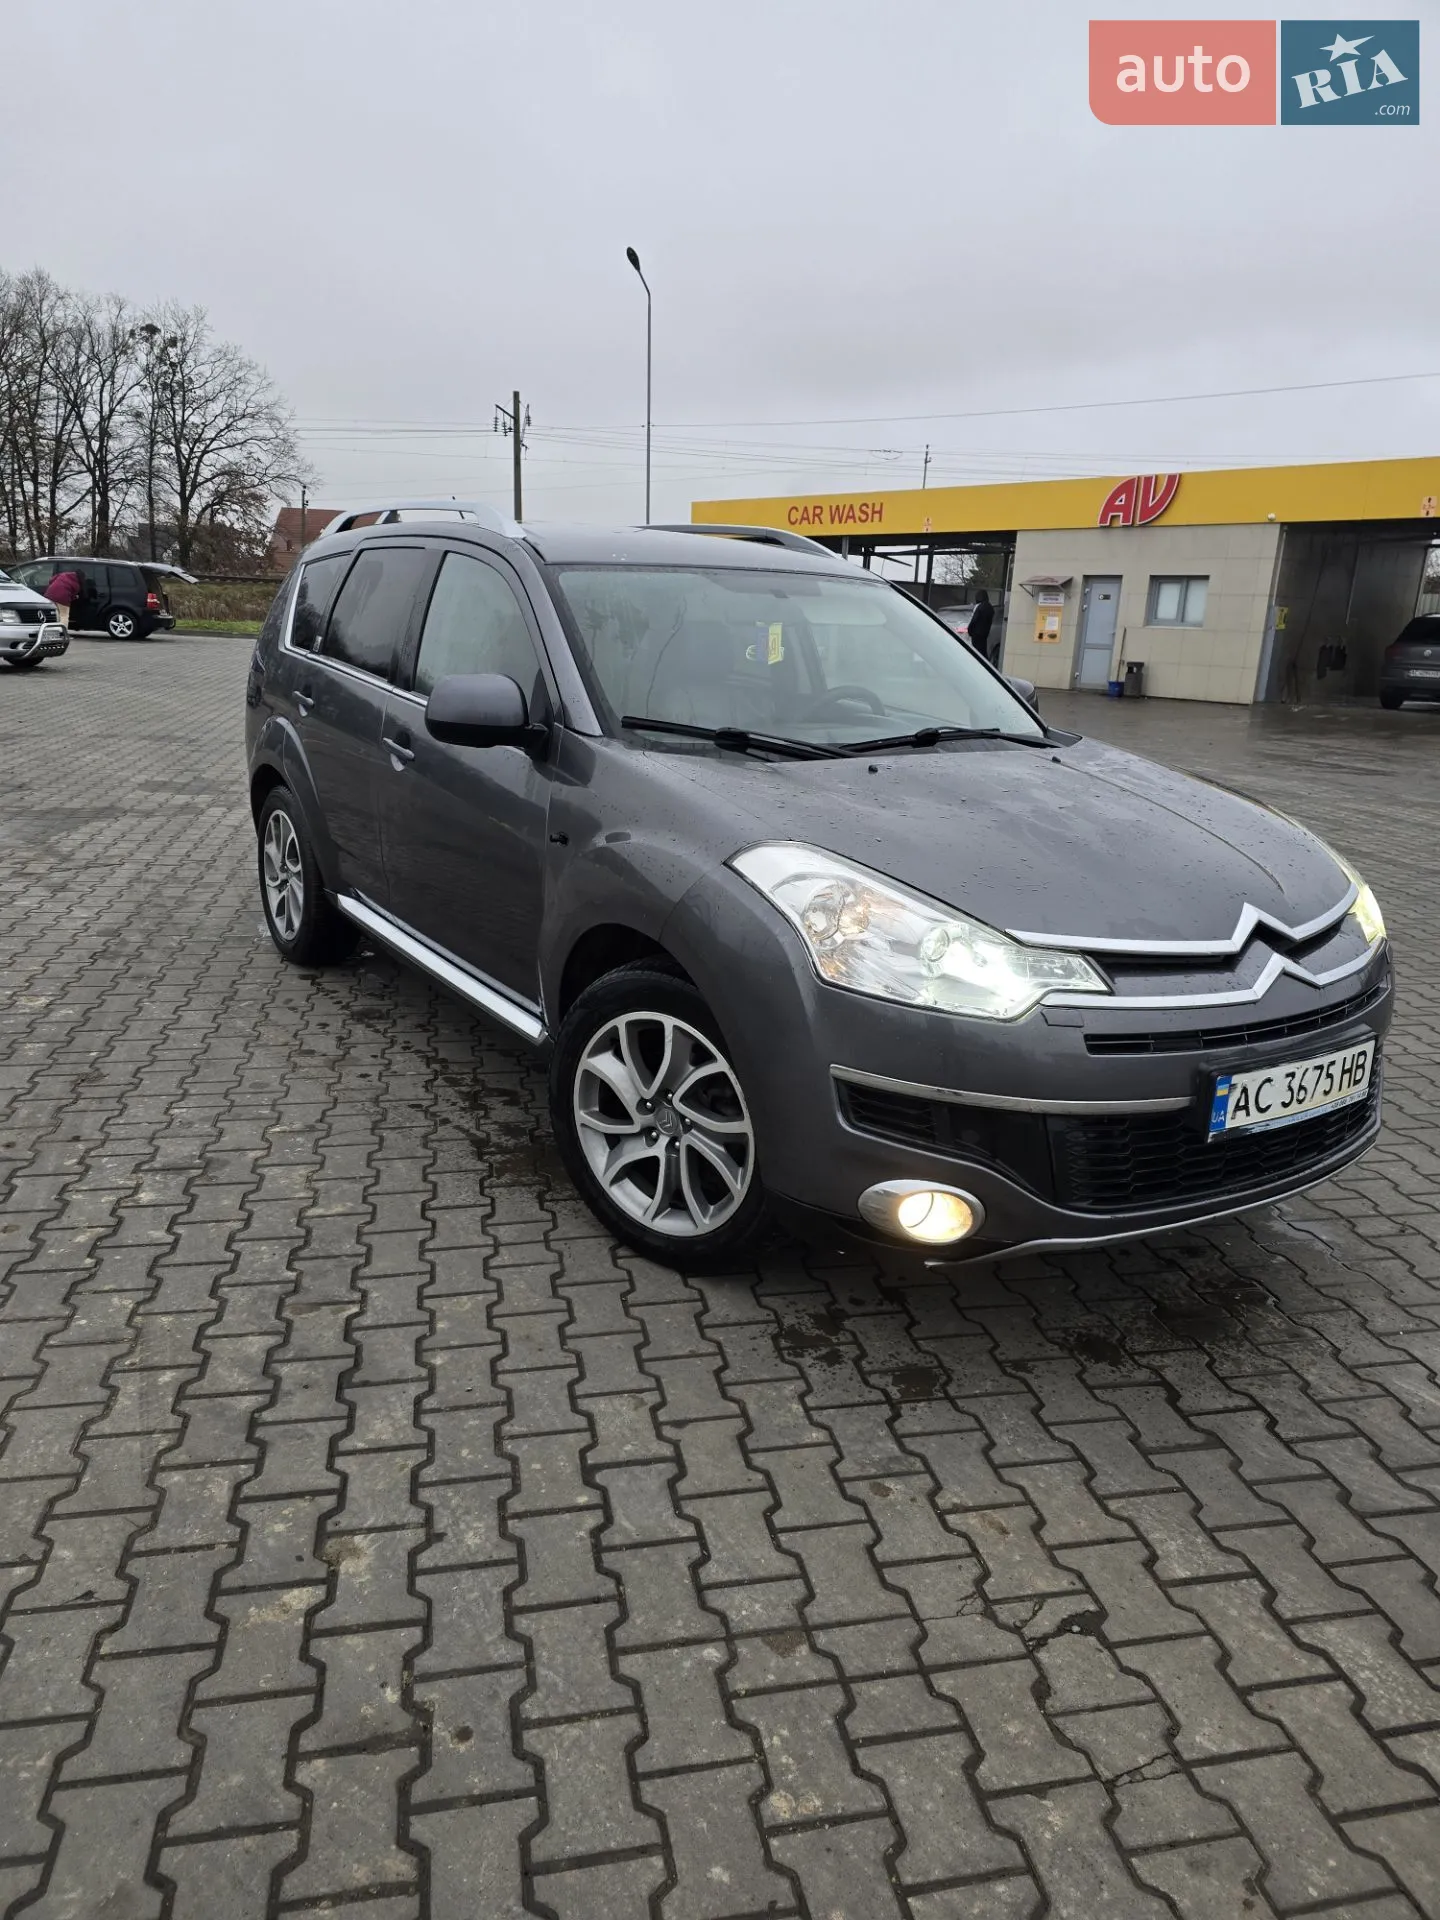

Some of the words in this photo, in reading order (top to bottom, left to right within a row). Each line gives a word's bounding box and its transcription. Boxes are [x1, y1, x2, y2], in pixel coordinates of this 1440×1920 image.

[788, 506, 823, 525] CAR
[829, 502, 883, 525] WASH
[1097, 473, 1180, 526] AV
[1231, 1077, 1273, 1120] AC
[1281, 1060, 1336, 1109] 3675
[1338, 1050, 1367, 1092] HB
[1211, 1112, 1225, 1124] UA
